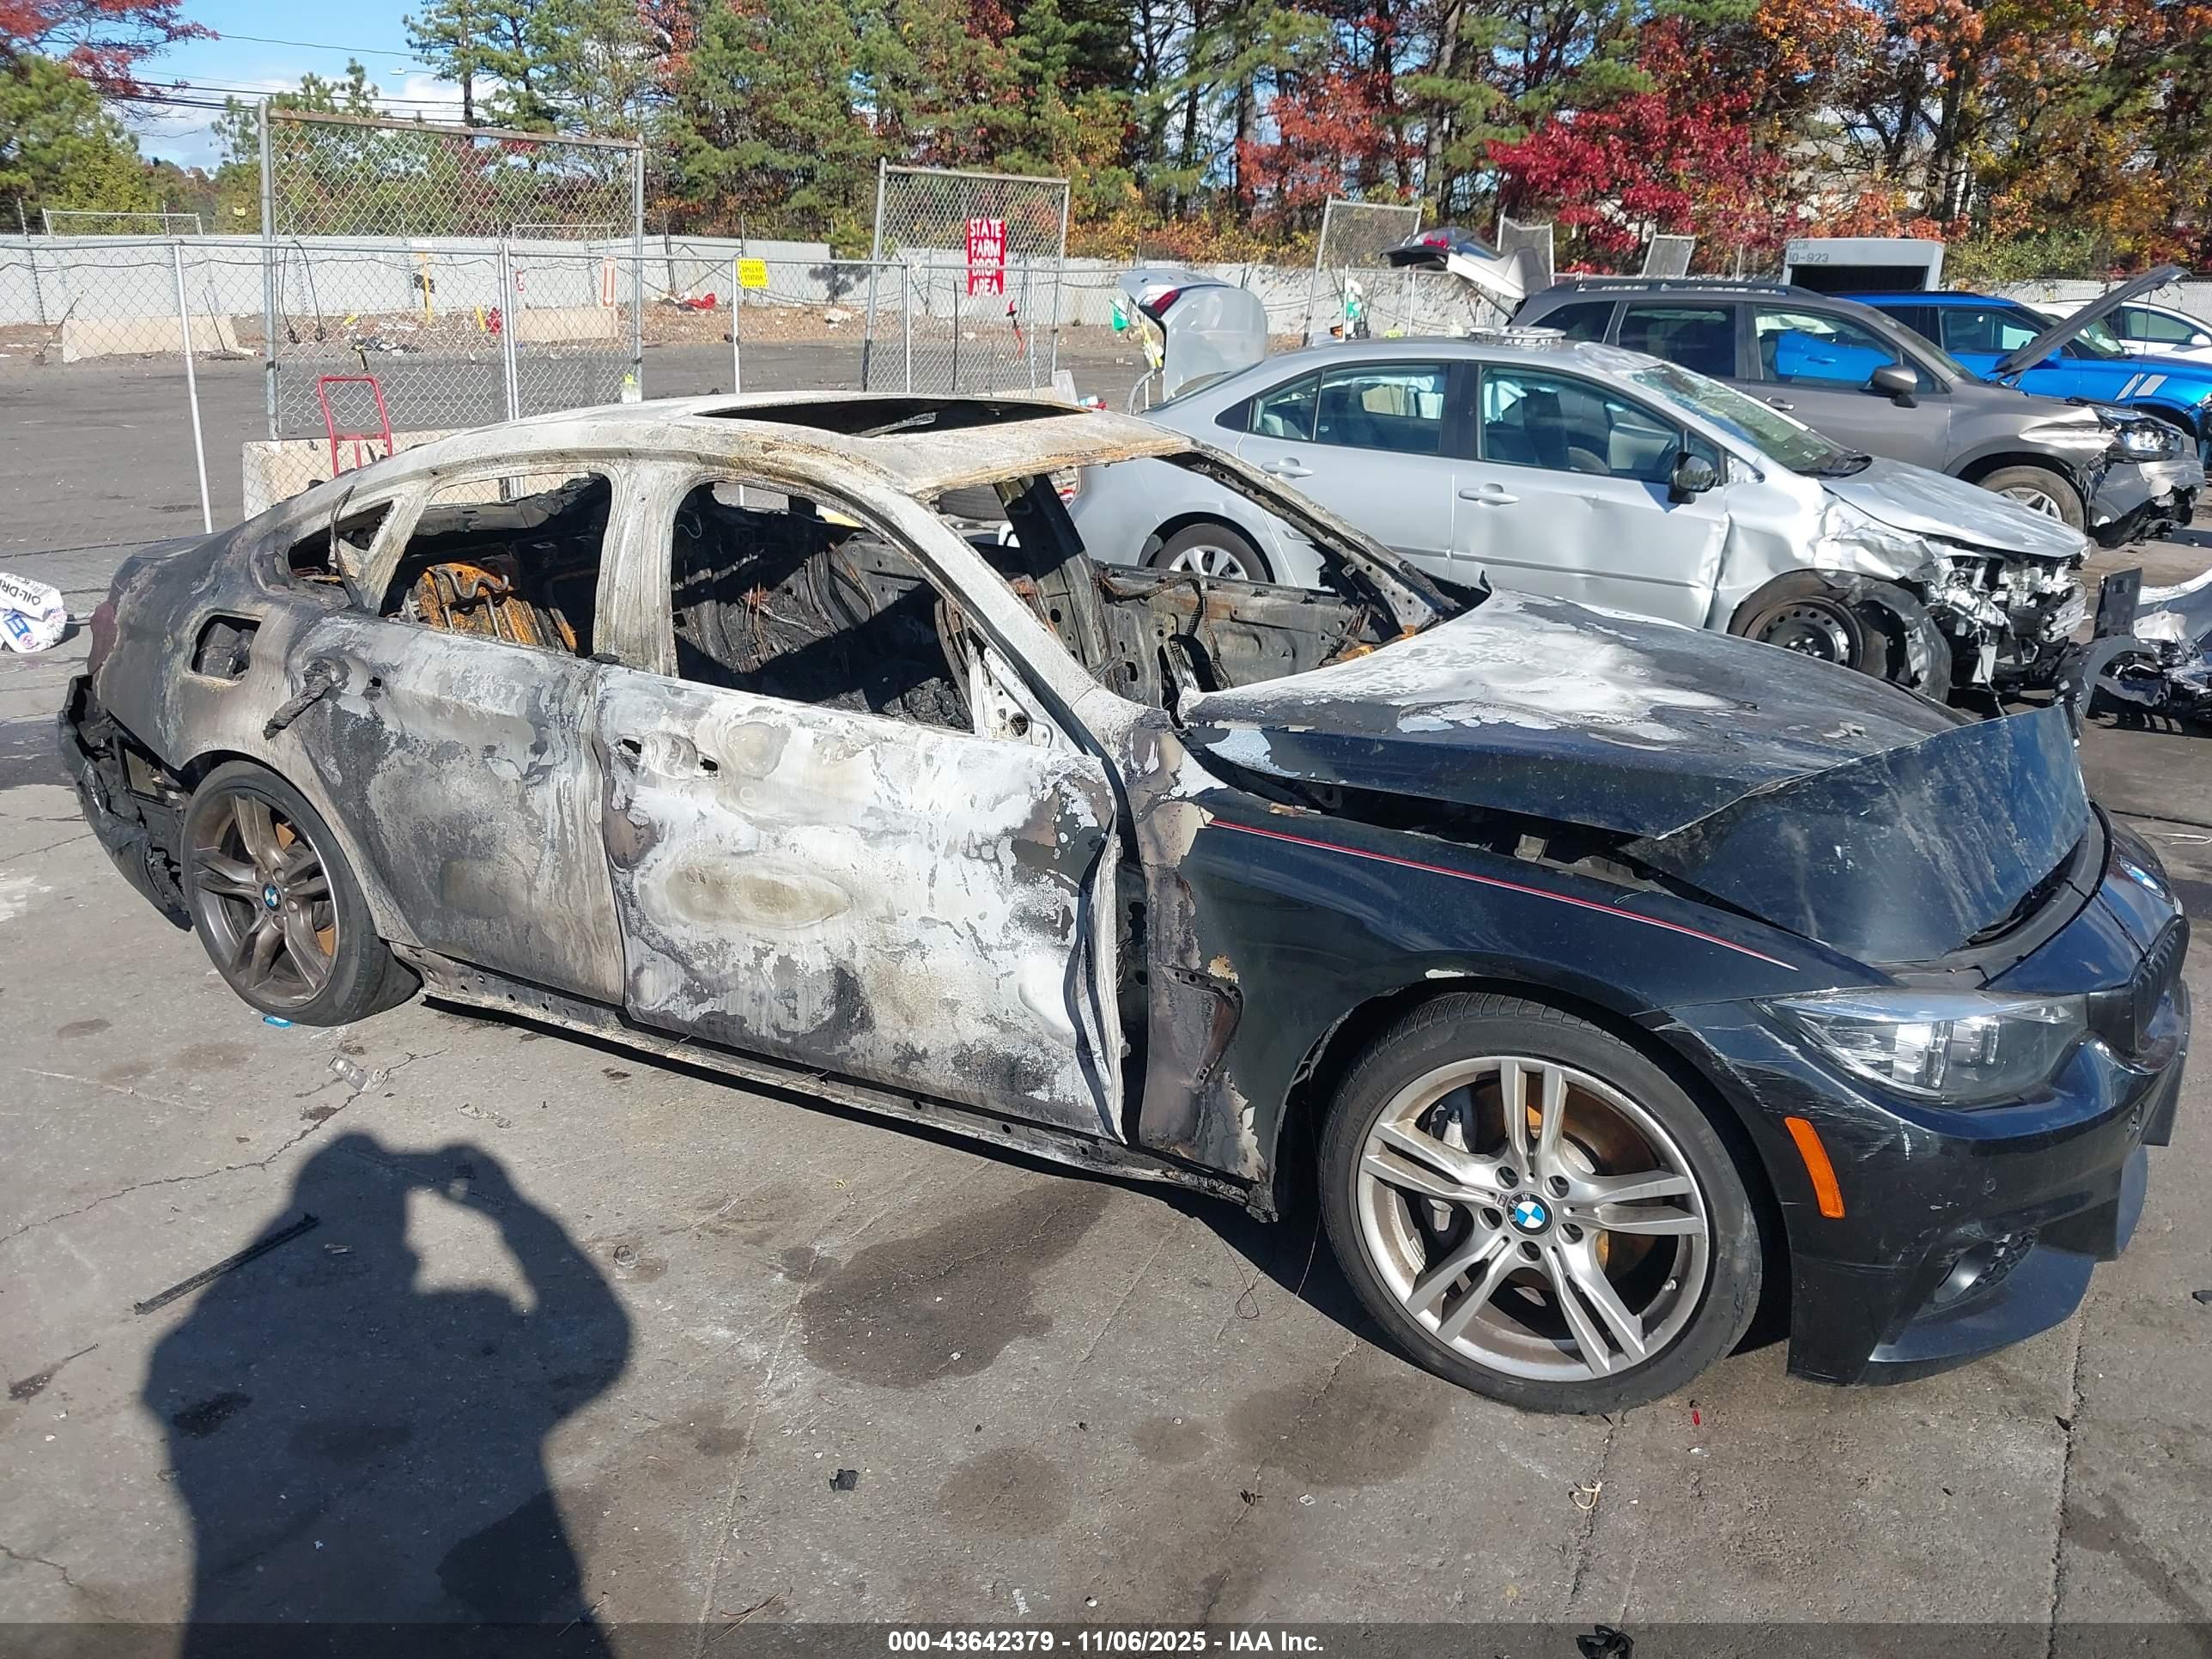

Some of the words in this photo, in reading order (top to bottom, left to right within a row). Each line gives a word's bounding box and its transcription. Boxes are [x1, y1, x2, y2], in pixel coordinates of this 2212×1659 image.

[969, 219, 1002, 238] STATE
[970, 239, 1000, 258] FARM
[971, 258, 1000, 276] DROP
[972, 277, 999, 296] AREA
